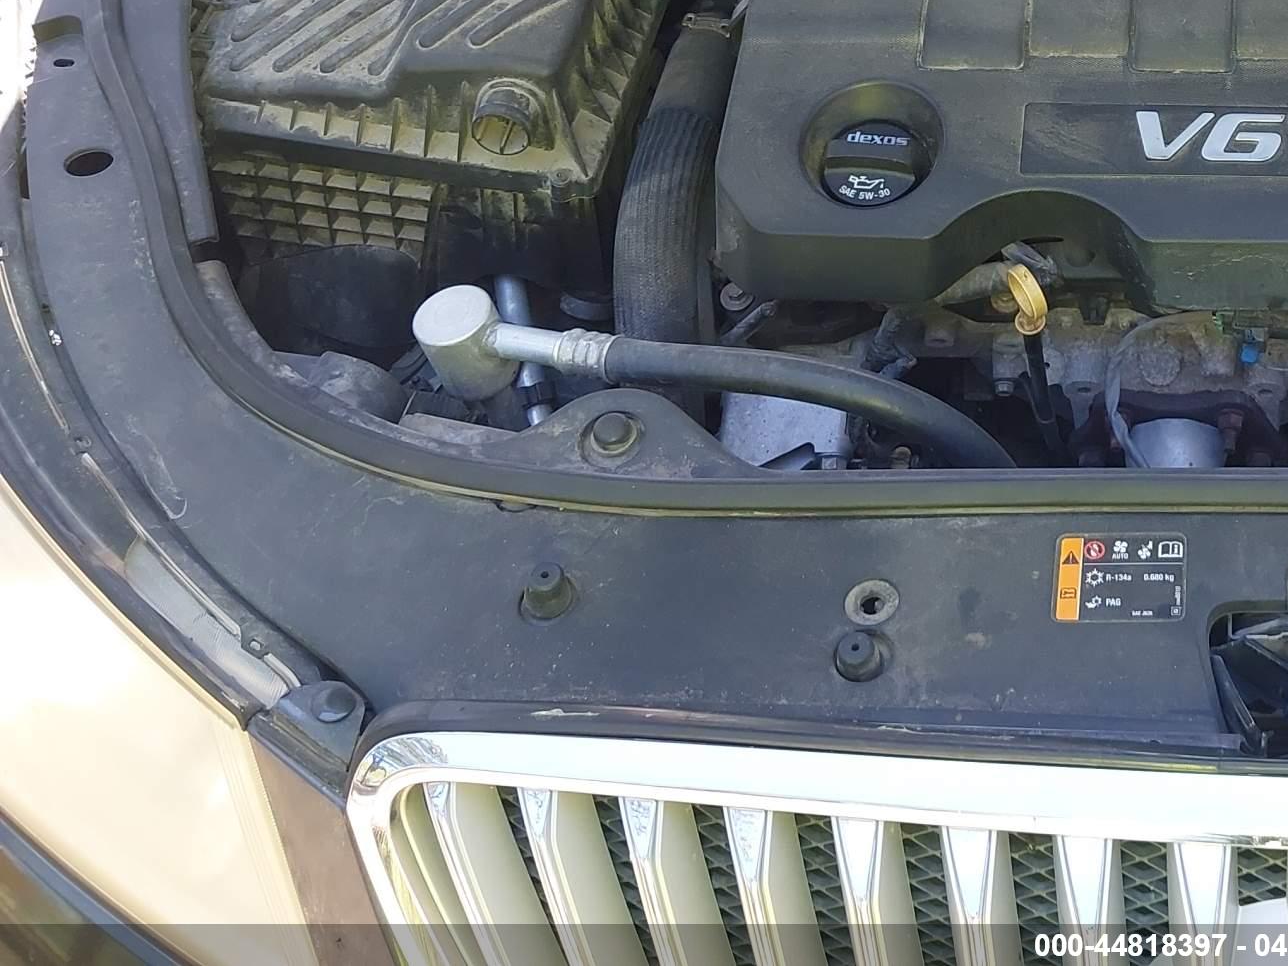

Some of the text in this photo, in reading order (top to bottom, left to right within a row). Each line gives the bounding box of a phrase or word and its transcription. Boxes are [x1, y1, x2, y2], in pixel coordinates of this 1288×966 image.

[848, 133, 910, 146] dexos
[1136, 111, 1286, 162] V6
[839, 185, 891, 200] SAE 5W-30
